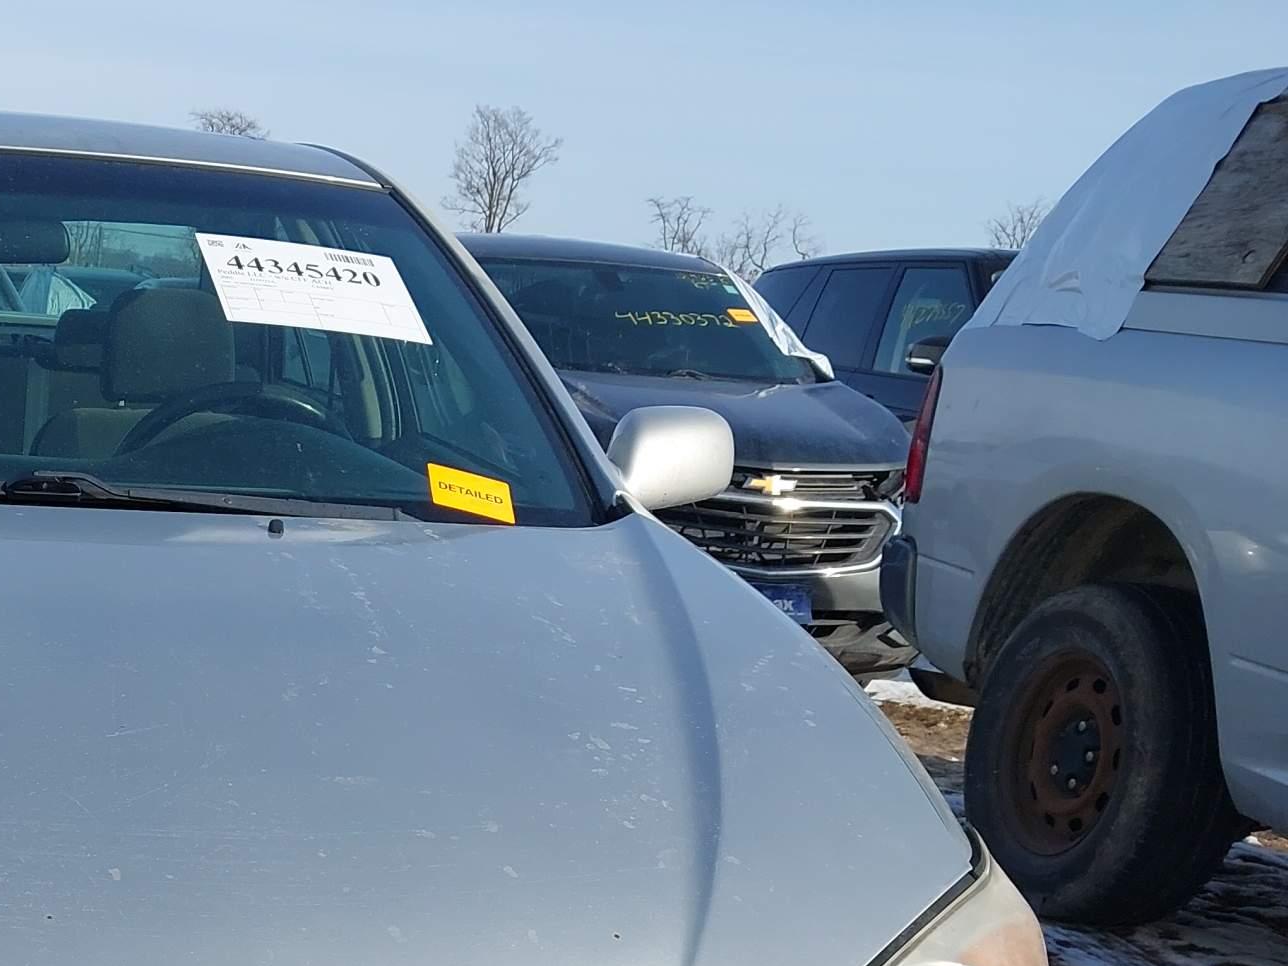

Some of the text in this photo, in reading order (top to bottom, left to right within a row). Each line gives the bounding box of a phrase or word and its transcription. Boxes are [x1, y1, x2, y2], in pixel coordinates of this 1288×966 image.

[227, 255, 381, 287] 44345420
[615, 311, 740, 328] 44330372
[438, 481, 504, 505] DETAILED
